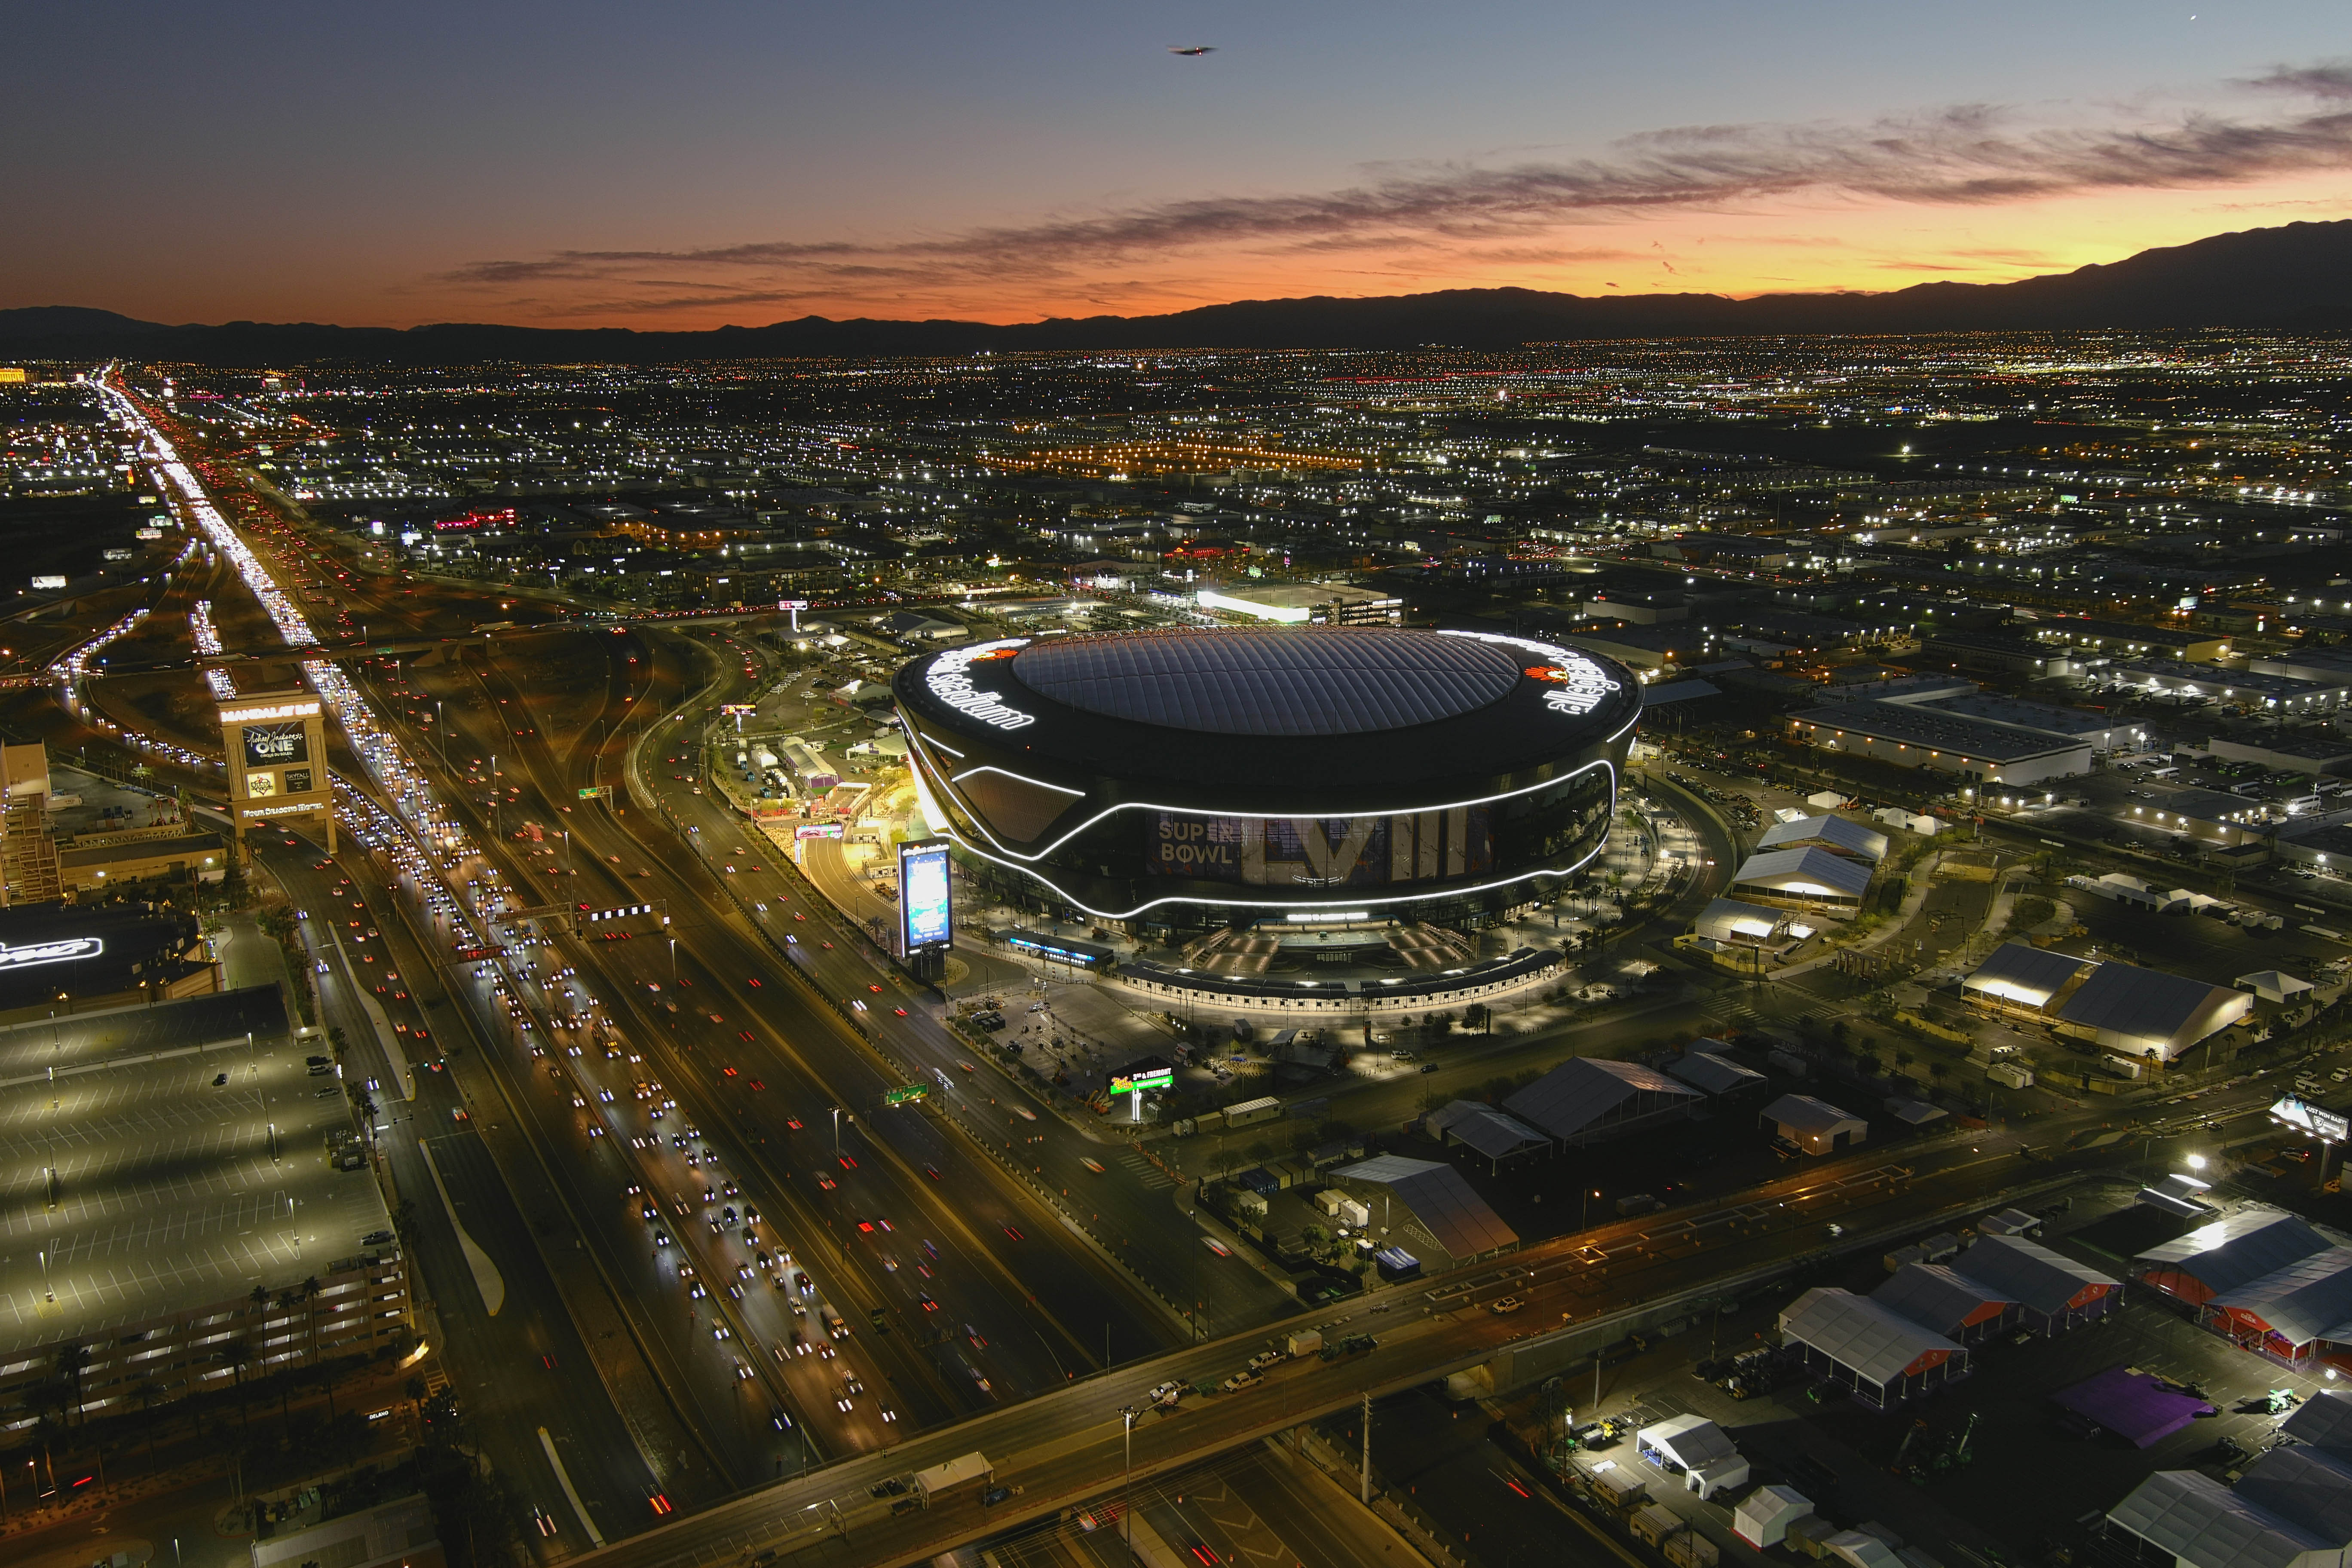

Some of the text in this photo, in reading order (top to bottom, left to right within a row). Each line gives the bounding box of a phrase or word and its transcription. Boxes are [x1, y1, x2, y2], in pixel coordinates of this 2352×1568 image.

[926, 674, 1035, 729] stadium
[221, 703, 319, 722] MANDALAY BAY
[247, 731, 297, 747] Michael Jackson
[256, 740, 294, 753] ONE
[265, 805, 297, 815] SEASONS
[297, 803, 324, 811] HOTEL
[1159, 820, 1234, 843] SUPER
[1161, 843, 1233, 864] BOWL
[1241, 808, 1468, 885] LVIII
[1147, 1068, 1171, 1078] FREMONT
[2305, 1106, 2347, 1125] JUST WIN BABY!
[370, 1411, 389, 1419] DELANO
